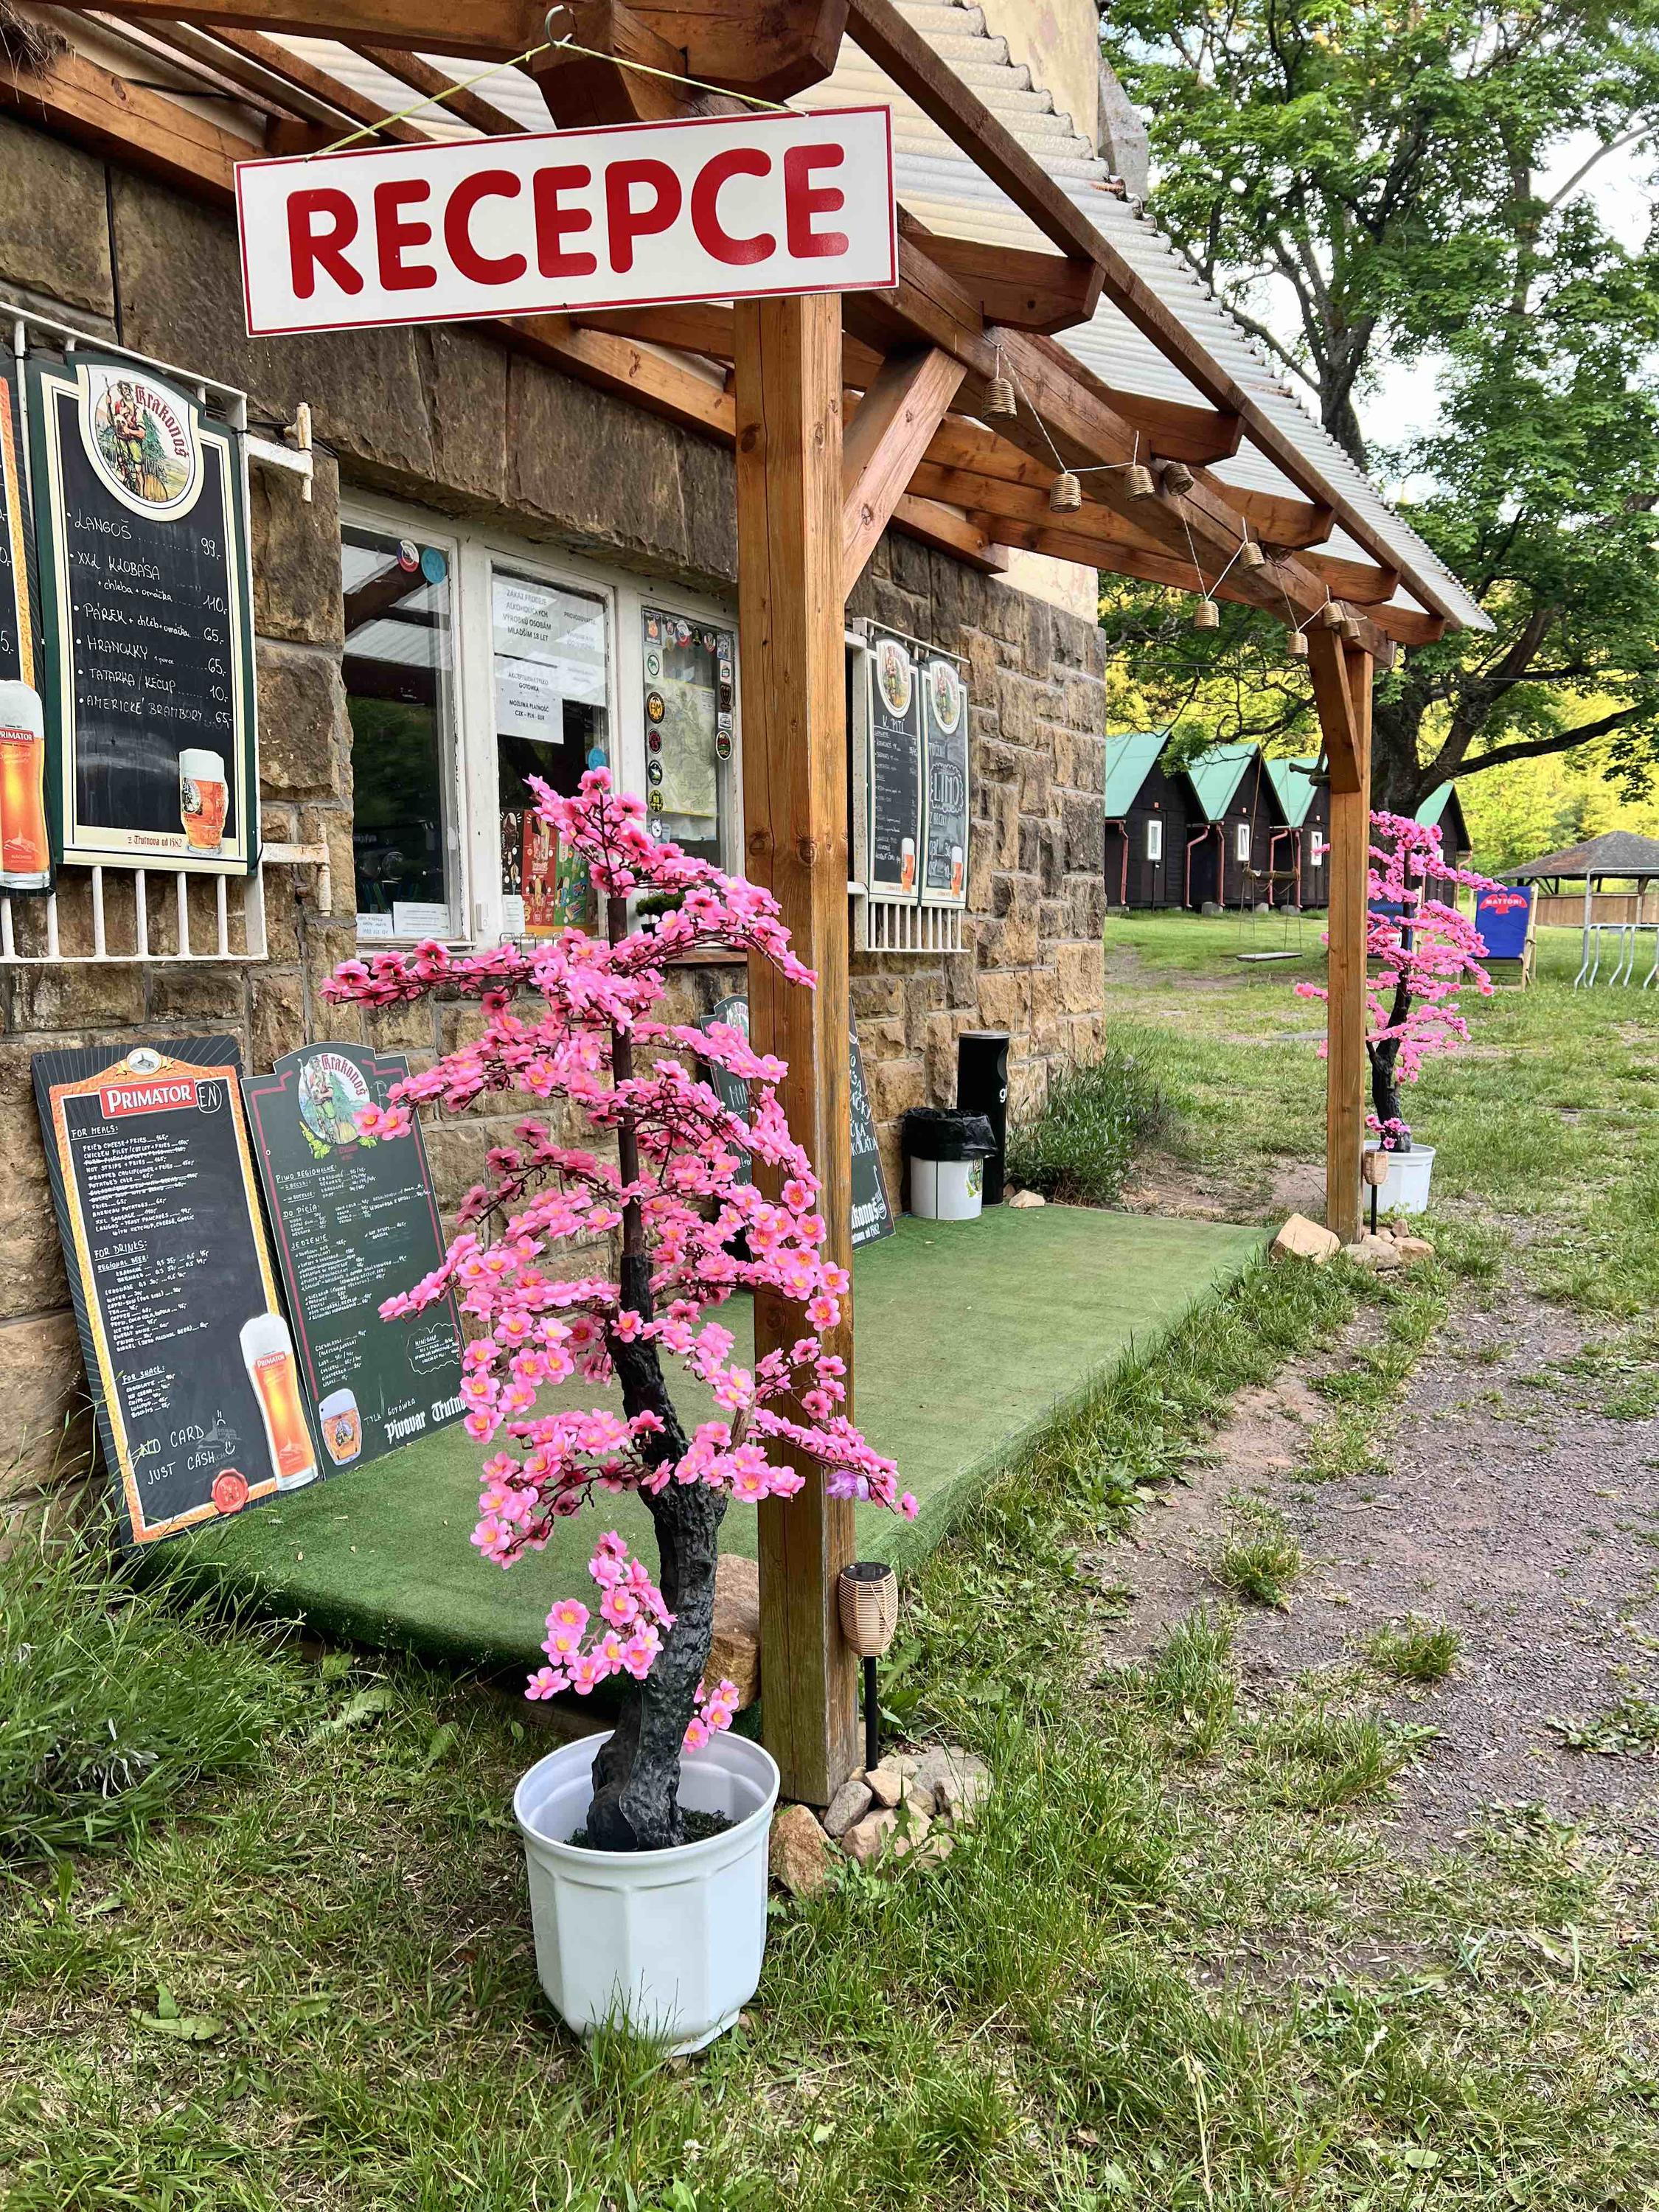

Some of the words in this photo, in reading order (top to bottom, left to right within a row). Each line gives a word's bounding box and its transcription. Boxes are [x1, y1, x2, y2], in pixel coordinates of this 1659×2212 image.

[286, 142, 850, 300] RECEPCE
[74, 507, 132, 540] LANGOŠ
[77, 551, 100, 569] XXL
[108, 554, 160, 581] KLOBÁSA
[104, 579, 133, 594] chleba
[83, 602, 128, 625] PÁREK
[87, 634, 147, 661] HRANOLKY
[89, 668, 136, 686] TATARKA
[145, 673, 176, 694] KEČUP
[86, 695, 145, 715] AMERICKÉ
[148, 702, 202, 722] BRAMBORY
[0, 731, 32, 741] RIMATOR
[198, 1085, 218, 1107] EN
[71, 1128, 87, 1138] FOR
[91, 1125, 118, 1135] MEALS:
[851, 1135, 878, 1157] KOLÁDA
[101, 1162, 122, 1172] STRIPS
[276, 1173, 294, 1183] PIWO
[852, 1197, 879, 1230] konoš
[94, 1248, 110, 1258] FOR
[113, 1239, 147, 1254] DRINKS:
[122, 1374, 136, 1382] FOR
[170, 1425, 205, 1447] CARD
[147, 1462, 175, 1485] JUST
[187, 1451, 215, 1470] CASH
